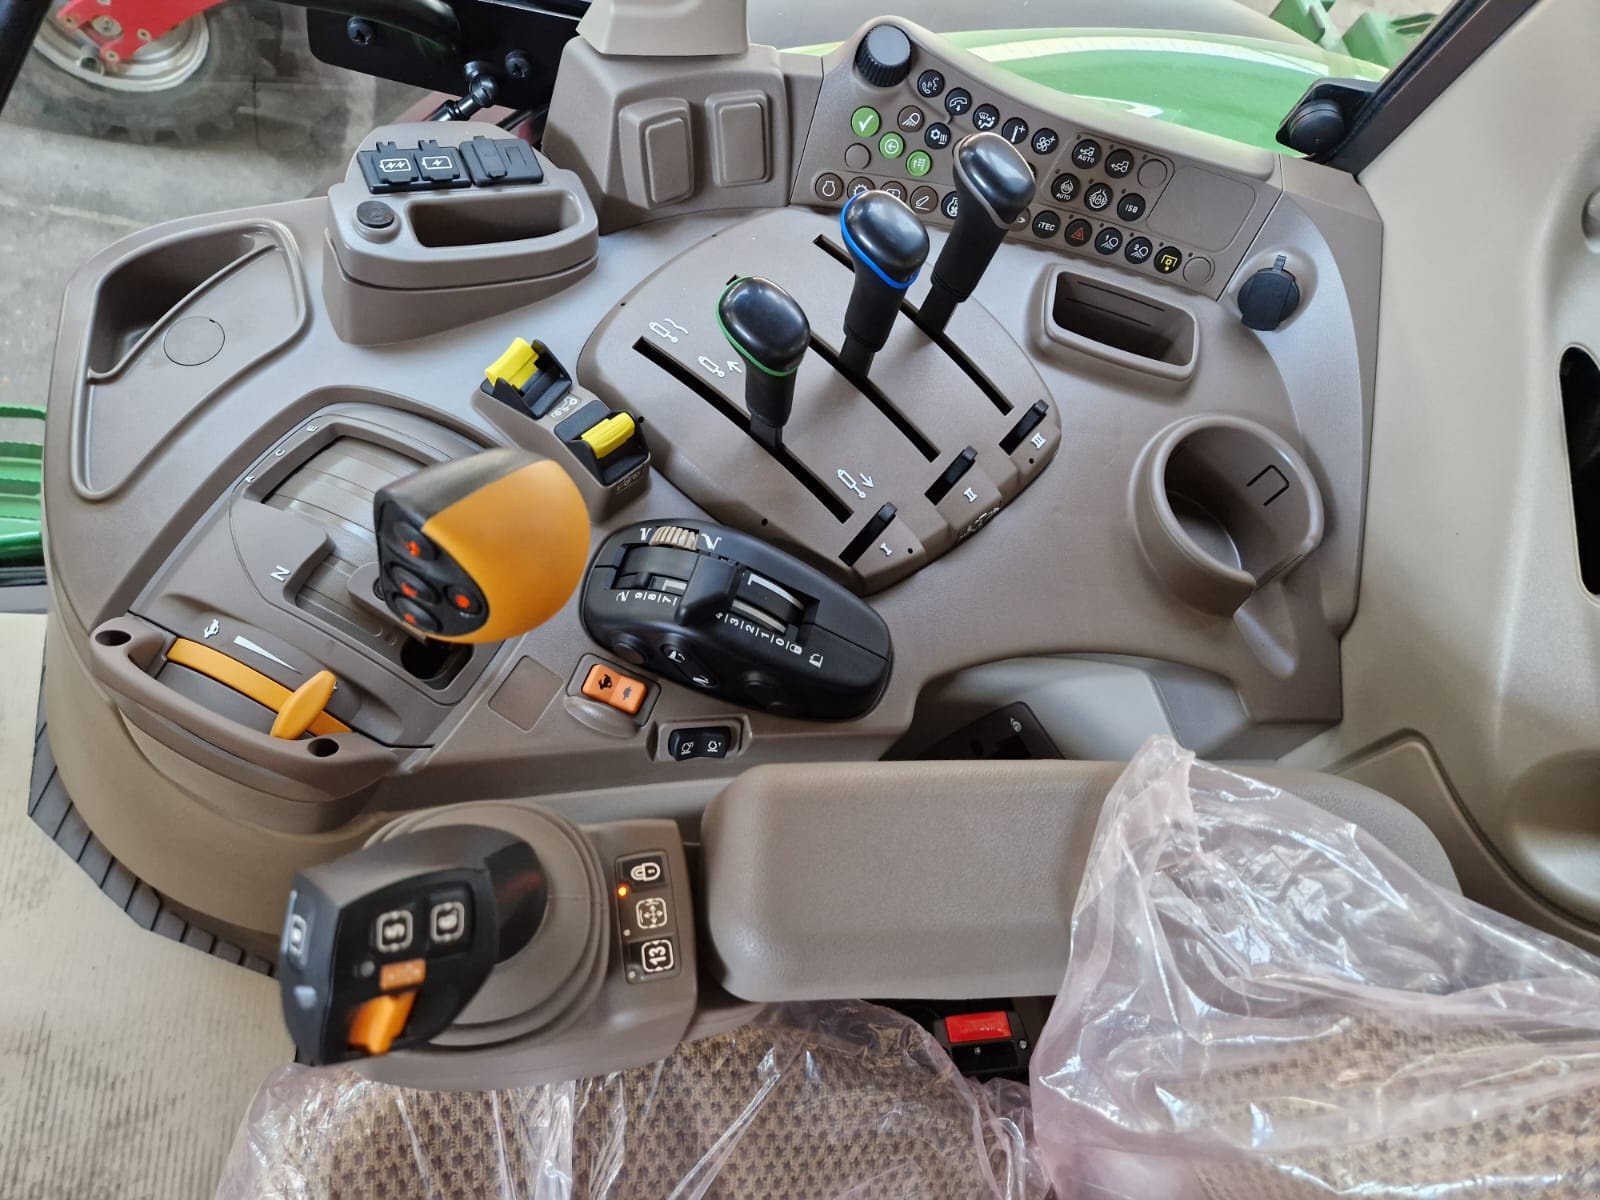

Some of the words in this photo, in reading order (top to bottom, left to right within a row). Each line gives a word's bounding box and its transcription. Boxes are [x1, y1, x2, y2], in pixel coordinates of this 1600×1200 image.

[1077, 154, 1095, 164] AUTO
[1055, 192, 1071, 200] AUTO
[1125, 203, 1139, 213] ISB
[1038, 221, 1056, 231] iTEC
[307, 424, 318, 432] E
[1031, 432, 1046, 448] III
[275, 449, 286, 457] C
[245, 475, 255, 483] A
[964, 487, 977, 503] II
[270, 564, 291, 583] N
[647, 593, 656, 601] 8
[662, 596, 672, 604] 7
[729, 617, 739, 627] 3
[745, 624, 755, 634] 2
[760, 631, 770, 639] 1
[775, 637, 785, 646] 0
[649, 946, 666, 966] 13
